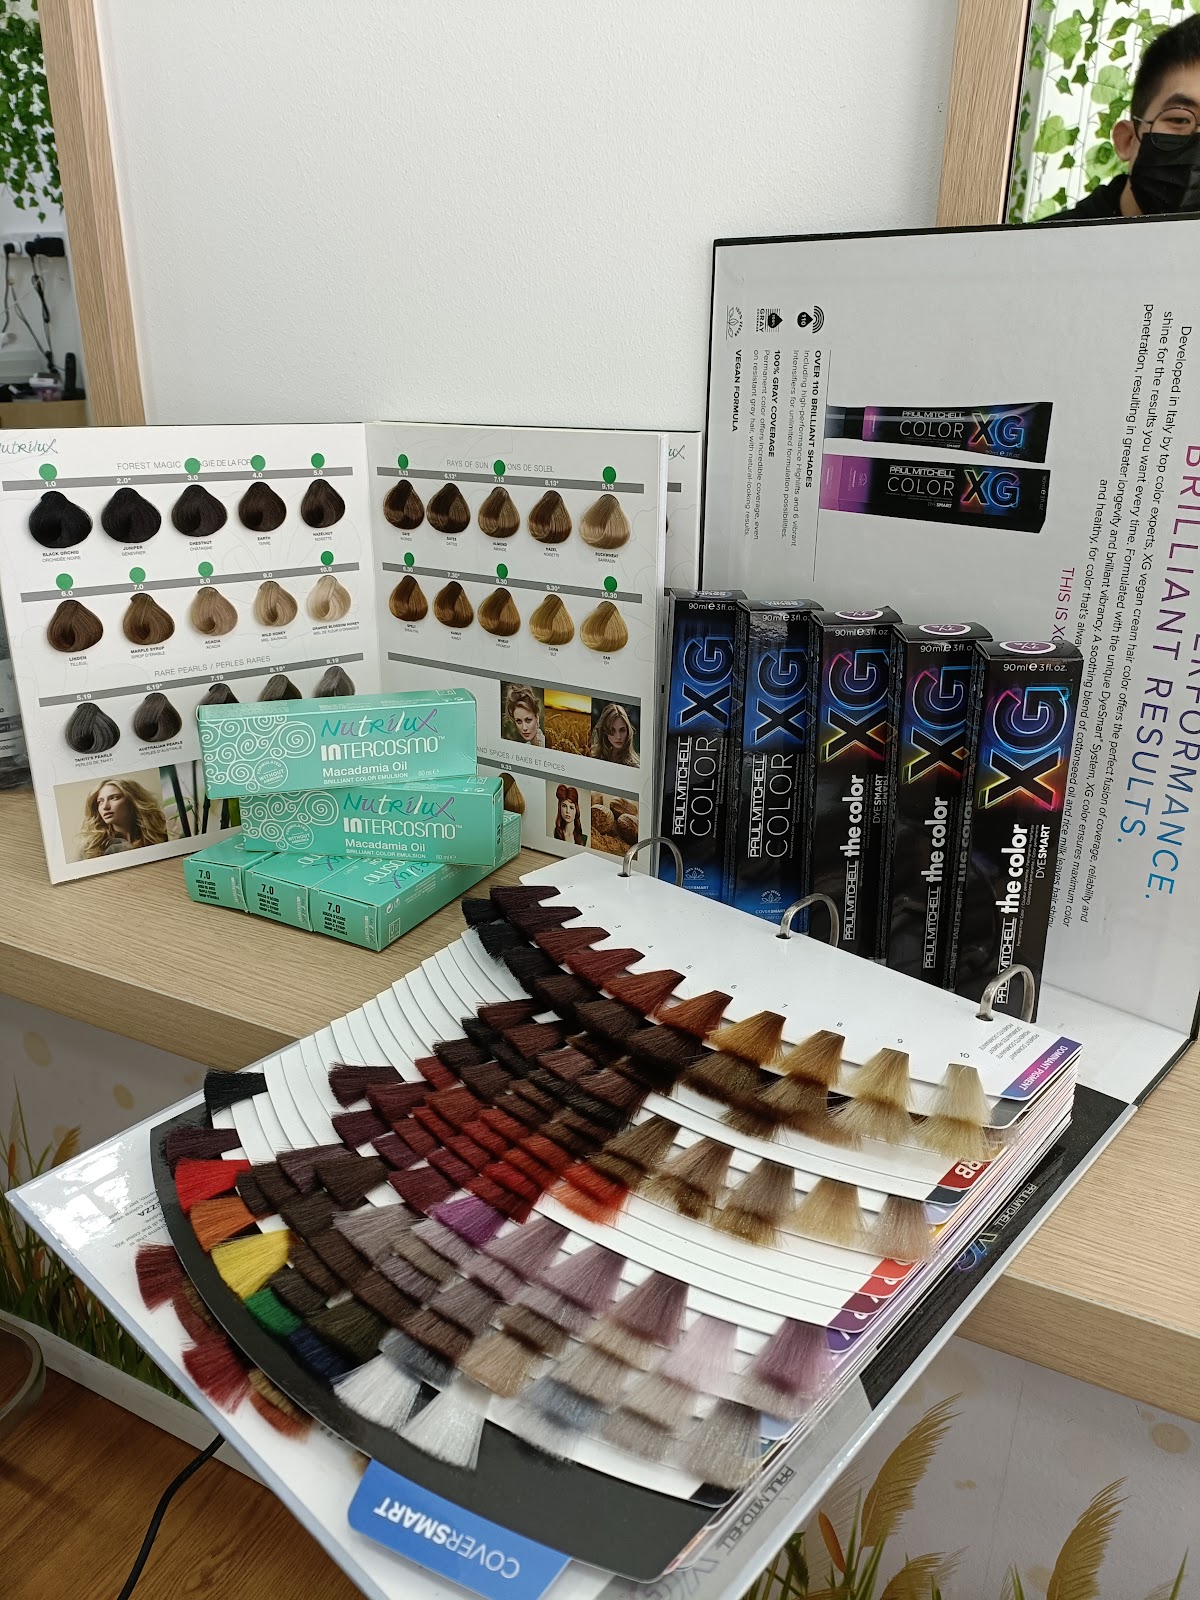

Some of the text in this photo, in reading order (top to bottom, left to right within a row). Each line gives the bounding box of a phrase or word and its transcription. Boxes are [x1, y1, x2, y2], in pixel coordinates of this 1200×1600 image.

[1160, 311, 1173, 344] shine
[1156, 347, 1168, 364] for
[731, 350, 742, 432] VEGAN FORMULA
[1153, 367, 1165, 386] the
[768, 350, 781, 458] 100% GRAY COVERAGE
[805, 350, 822, 488] OVER 110 BRILLIANT SHADES
[1146, 389, 1159, 428] results
[900, 420, 964, 439] COLOR
[967, 412, 1025, 449] XG
[1142, 430, 1153, 452] you
[117, 459, 237, 470] FOREST MAGIC DE LA
[446, 459, 463, 468] RAYS
[534, 464, 554, 473] SOLEIL
[889, 466, 955, 478] PAUL MITCHELL
[1136, 455, 1149, 482] want
[887, 476, 955, 497] COLOR
[960, 468, 1020, 508] XG
[1129, 485, 1144, 517] every
[1078, 479, 1108, 620] and healthy, for color that's
[1126, 519, 1139, 545] time.
[1061, 304, 1154, 836] penetration, resulting in greater longevity and brilliant vibrancy. soothing blend cottonseed oil and rice
[1116, 548, 1136, 609] Formulated
[1055, 567, 1075, 621] THIS IS
[1080, 326, 1192, 923] Developed in Italy by top color experts, XG vegan cream hair color offers the perfect fusion of coverage, reliability and
[1112, 611, 1123, 633] with
[1109, 634, 1120, 652] the
[1117, 446, 1200, 842] BRILLIANT RESULTS.
[154, 655, 271, 678] RARE PEARLS PERLES RARES
[679, 636, 733, 727] XG
[1102, 654, 1115, 689] unique
[753, 649, 808, 746] XG
[825, 649, 889, 762] XG
[903, 666, 970, 784] XG
[489, 750, 510, 760] SPICES
[515, 755, 533, 765] BAIES
[978, 685, 1069, 810] XG
[1086, 743, 1102, 780] System,
[258, 769, 285, 781] WITHOUT
[323, 761, 408, 778] Macadamia Oil
[323, 777, 354, 785] BRILLIANT
[673, 737, 692, 835] PAUL MITCHELL
[690, 736, 718, 837] COLOR
[749, 755, 767, 858] PAUL MITCHELL
[765, 753, 794, 858] COLOR
[873, 774, 885, 824] DYESMART
[1084, 782, 1095, 798] XG
[1081, 799, 1091, 823] color
[345, 838, 426, 852] Macadamia Oil
[840, 774, 864, 940] PAUL MITCHELL the color
[1001, 824, 1028, 878] color
[1035, 824, 1051, 879] DYESMART
[1073, 824, 1087, 860] ensures
[199, 869, 211, 880] 7.0
[261, 884, 274, 895] 7.0
[921, 797, 948, 968] PAUL MITCHELL the color
[1066, 861, 1080, 904] maximum
[327, 902, 341, 914] 7.0
[995, 881, 1021, 914] the
[1062, 905, 1073, 928] color
[1018, 1045, 1069, 1091] DOMINANT PIGMENT
[373, 1496, 521, 1580] COVERSMART
